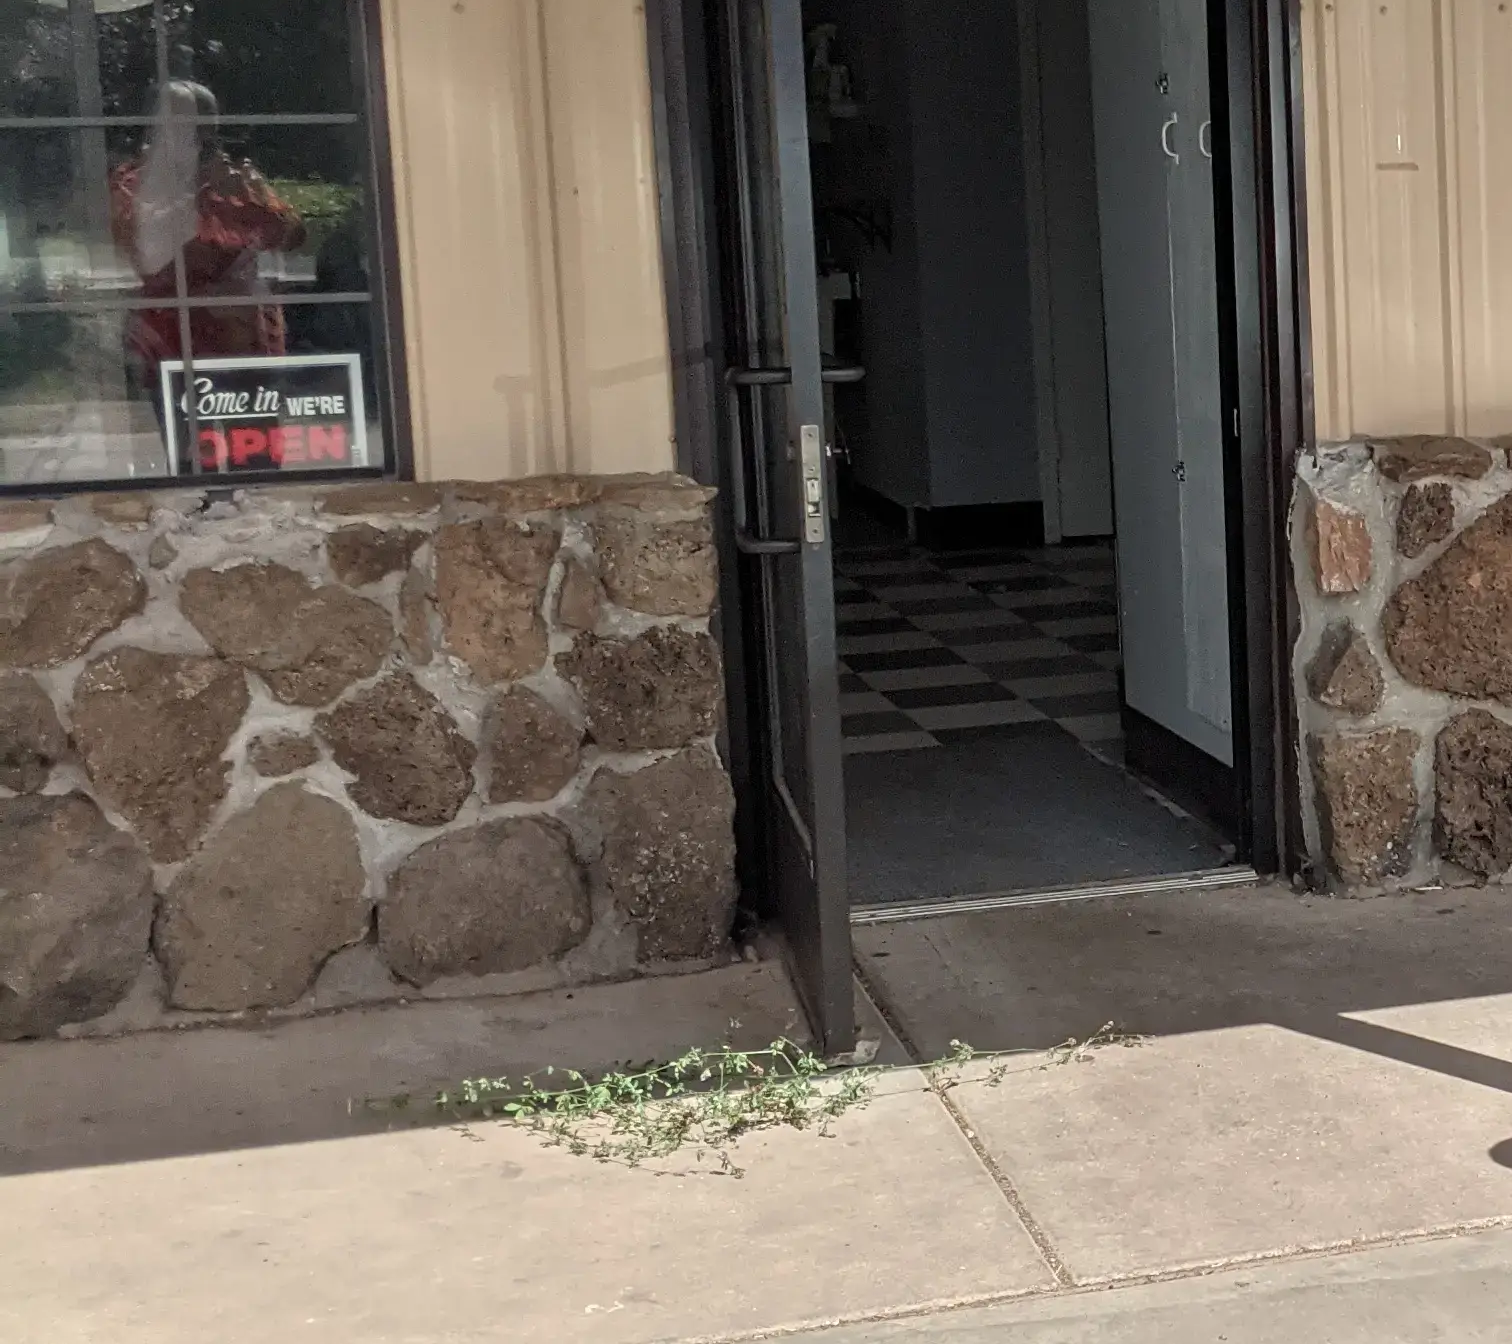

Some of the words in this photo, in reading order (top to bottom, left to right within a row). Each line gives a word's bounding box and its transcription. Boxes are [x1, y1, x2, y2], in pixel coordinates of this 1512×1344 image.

[181, 378, 249, 415] Come
[254, 385, 280, 411] in
[286, 396, 345, 416] WE'RE
[190, 423, 346, 467] OPEN
